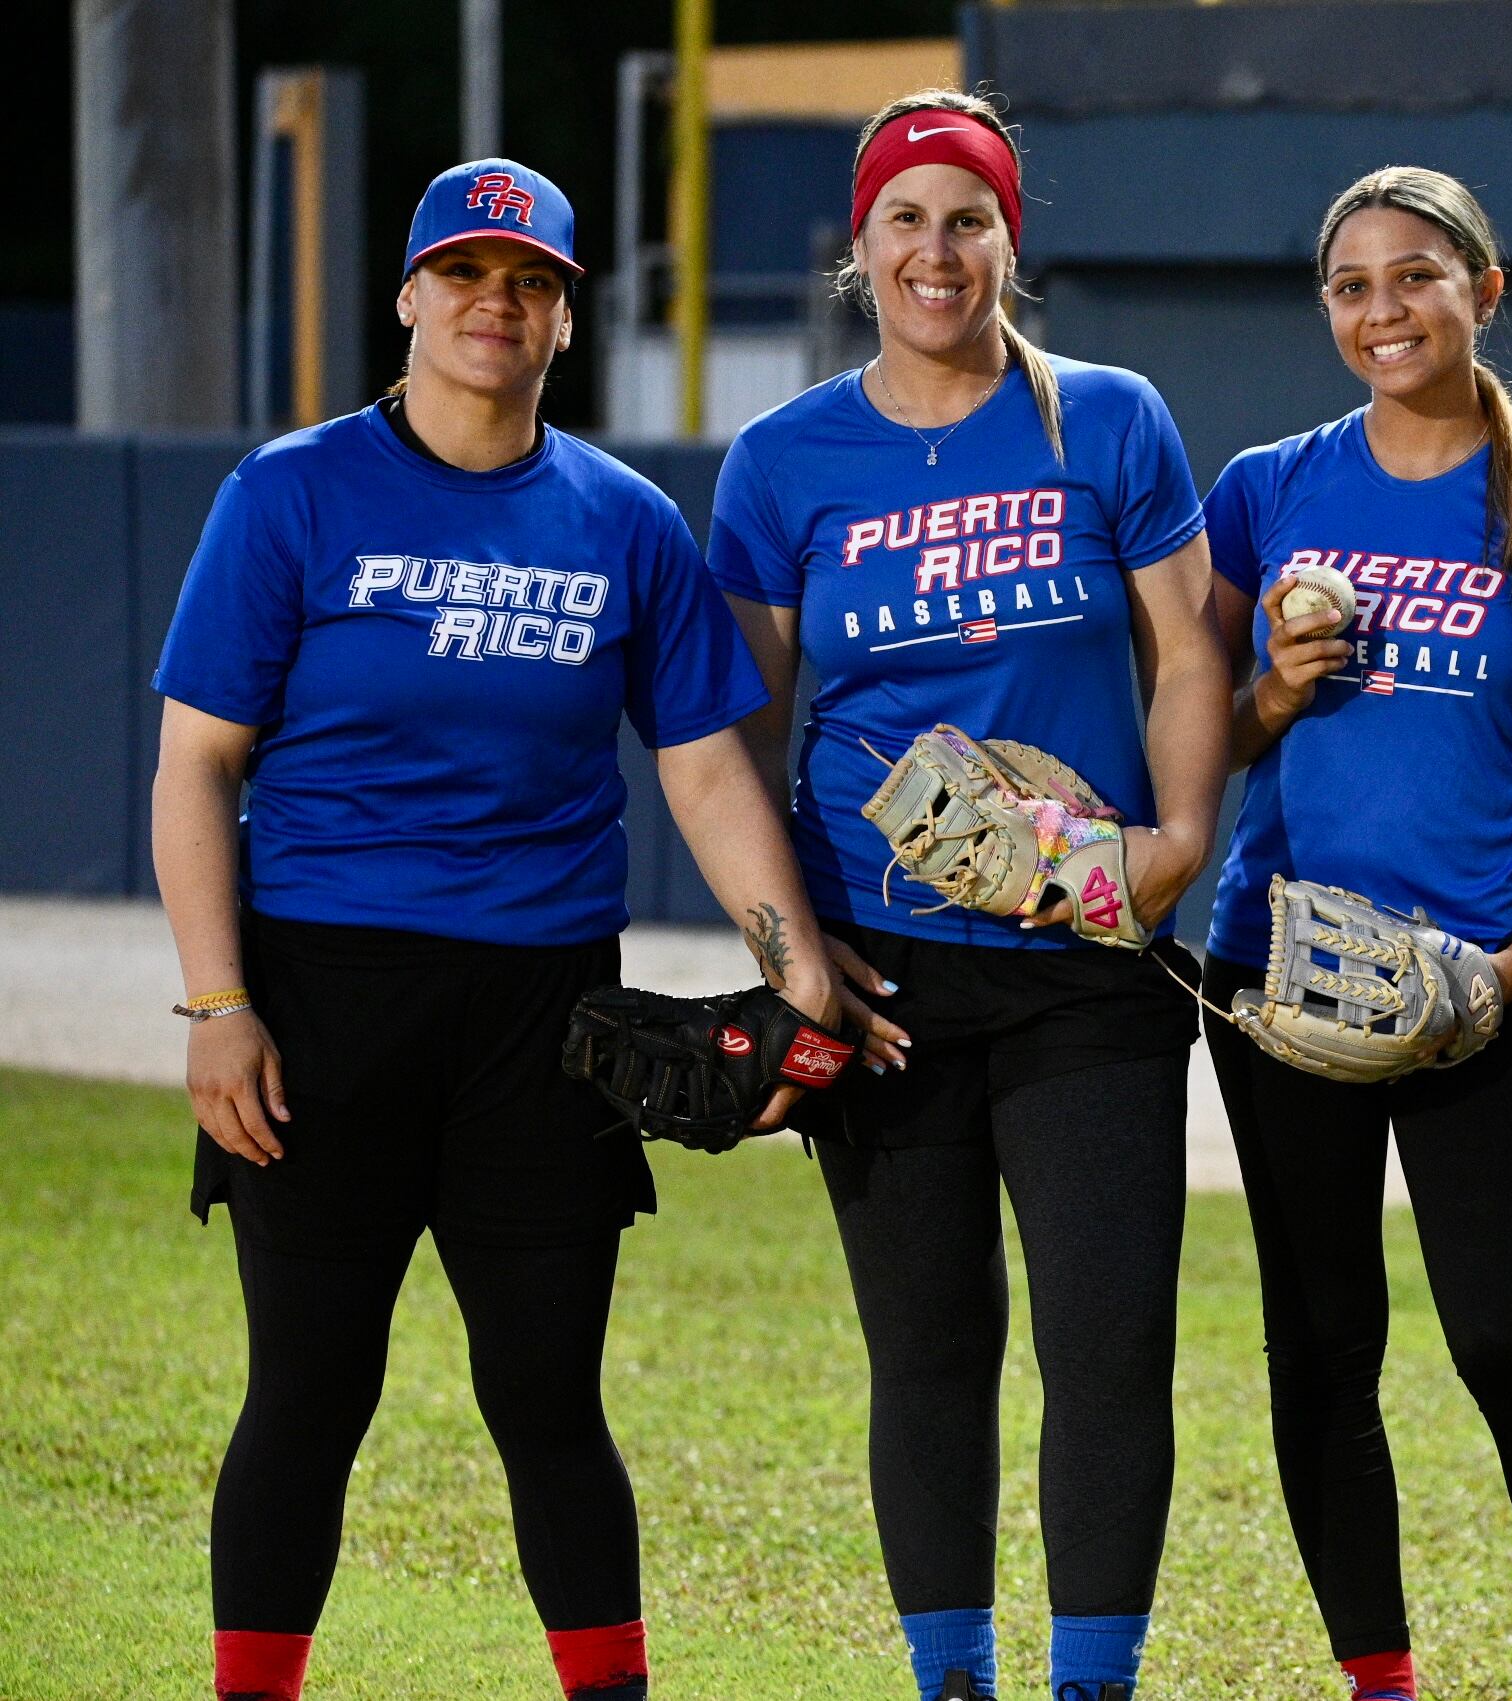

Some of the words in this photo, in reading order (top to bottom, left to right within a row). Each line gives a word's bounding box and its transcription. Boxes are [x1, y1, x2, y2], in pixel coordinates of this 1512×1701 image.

[466, 173, 534, 227] PR
[841, 488, 1066, 566] PUERTO
[348, 555, 609, 618] PUERTO
[914, 529, 1065, 594] RICO
[427, 606, 596, 665] RICO
[844, 576, 1089, 638] BASEBALL
[1356, 640, 1488, 680] EBALL
[1081, 866, 1123, 929] 44
[1467, 973, 1499, 1036] 44
[792, 1049, 843, 1076] Rawlings
